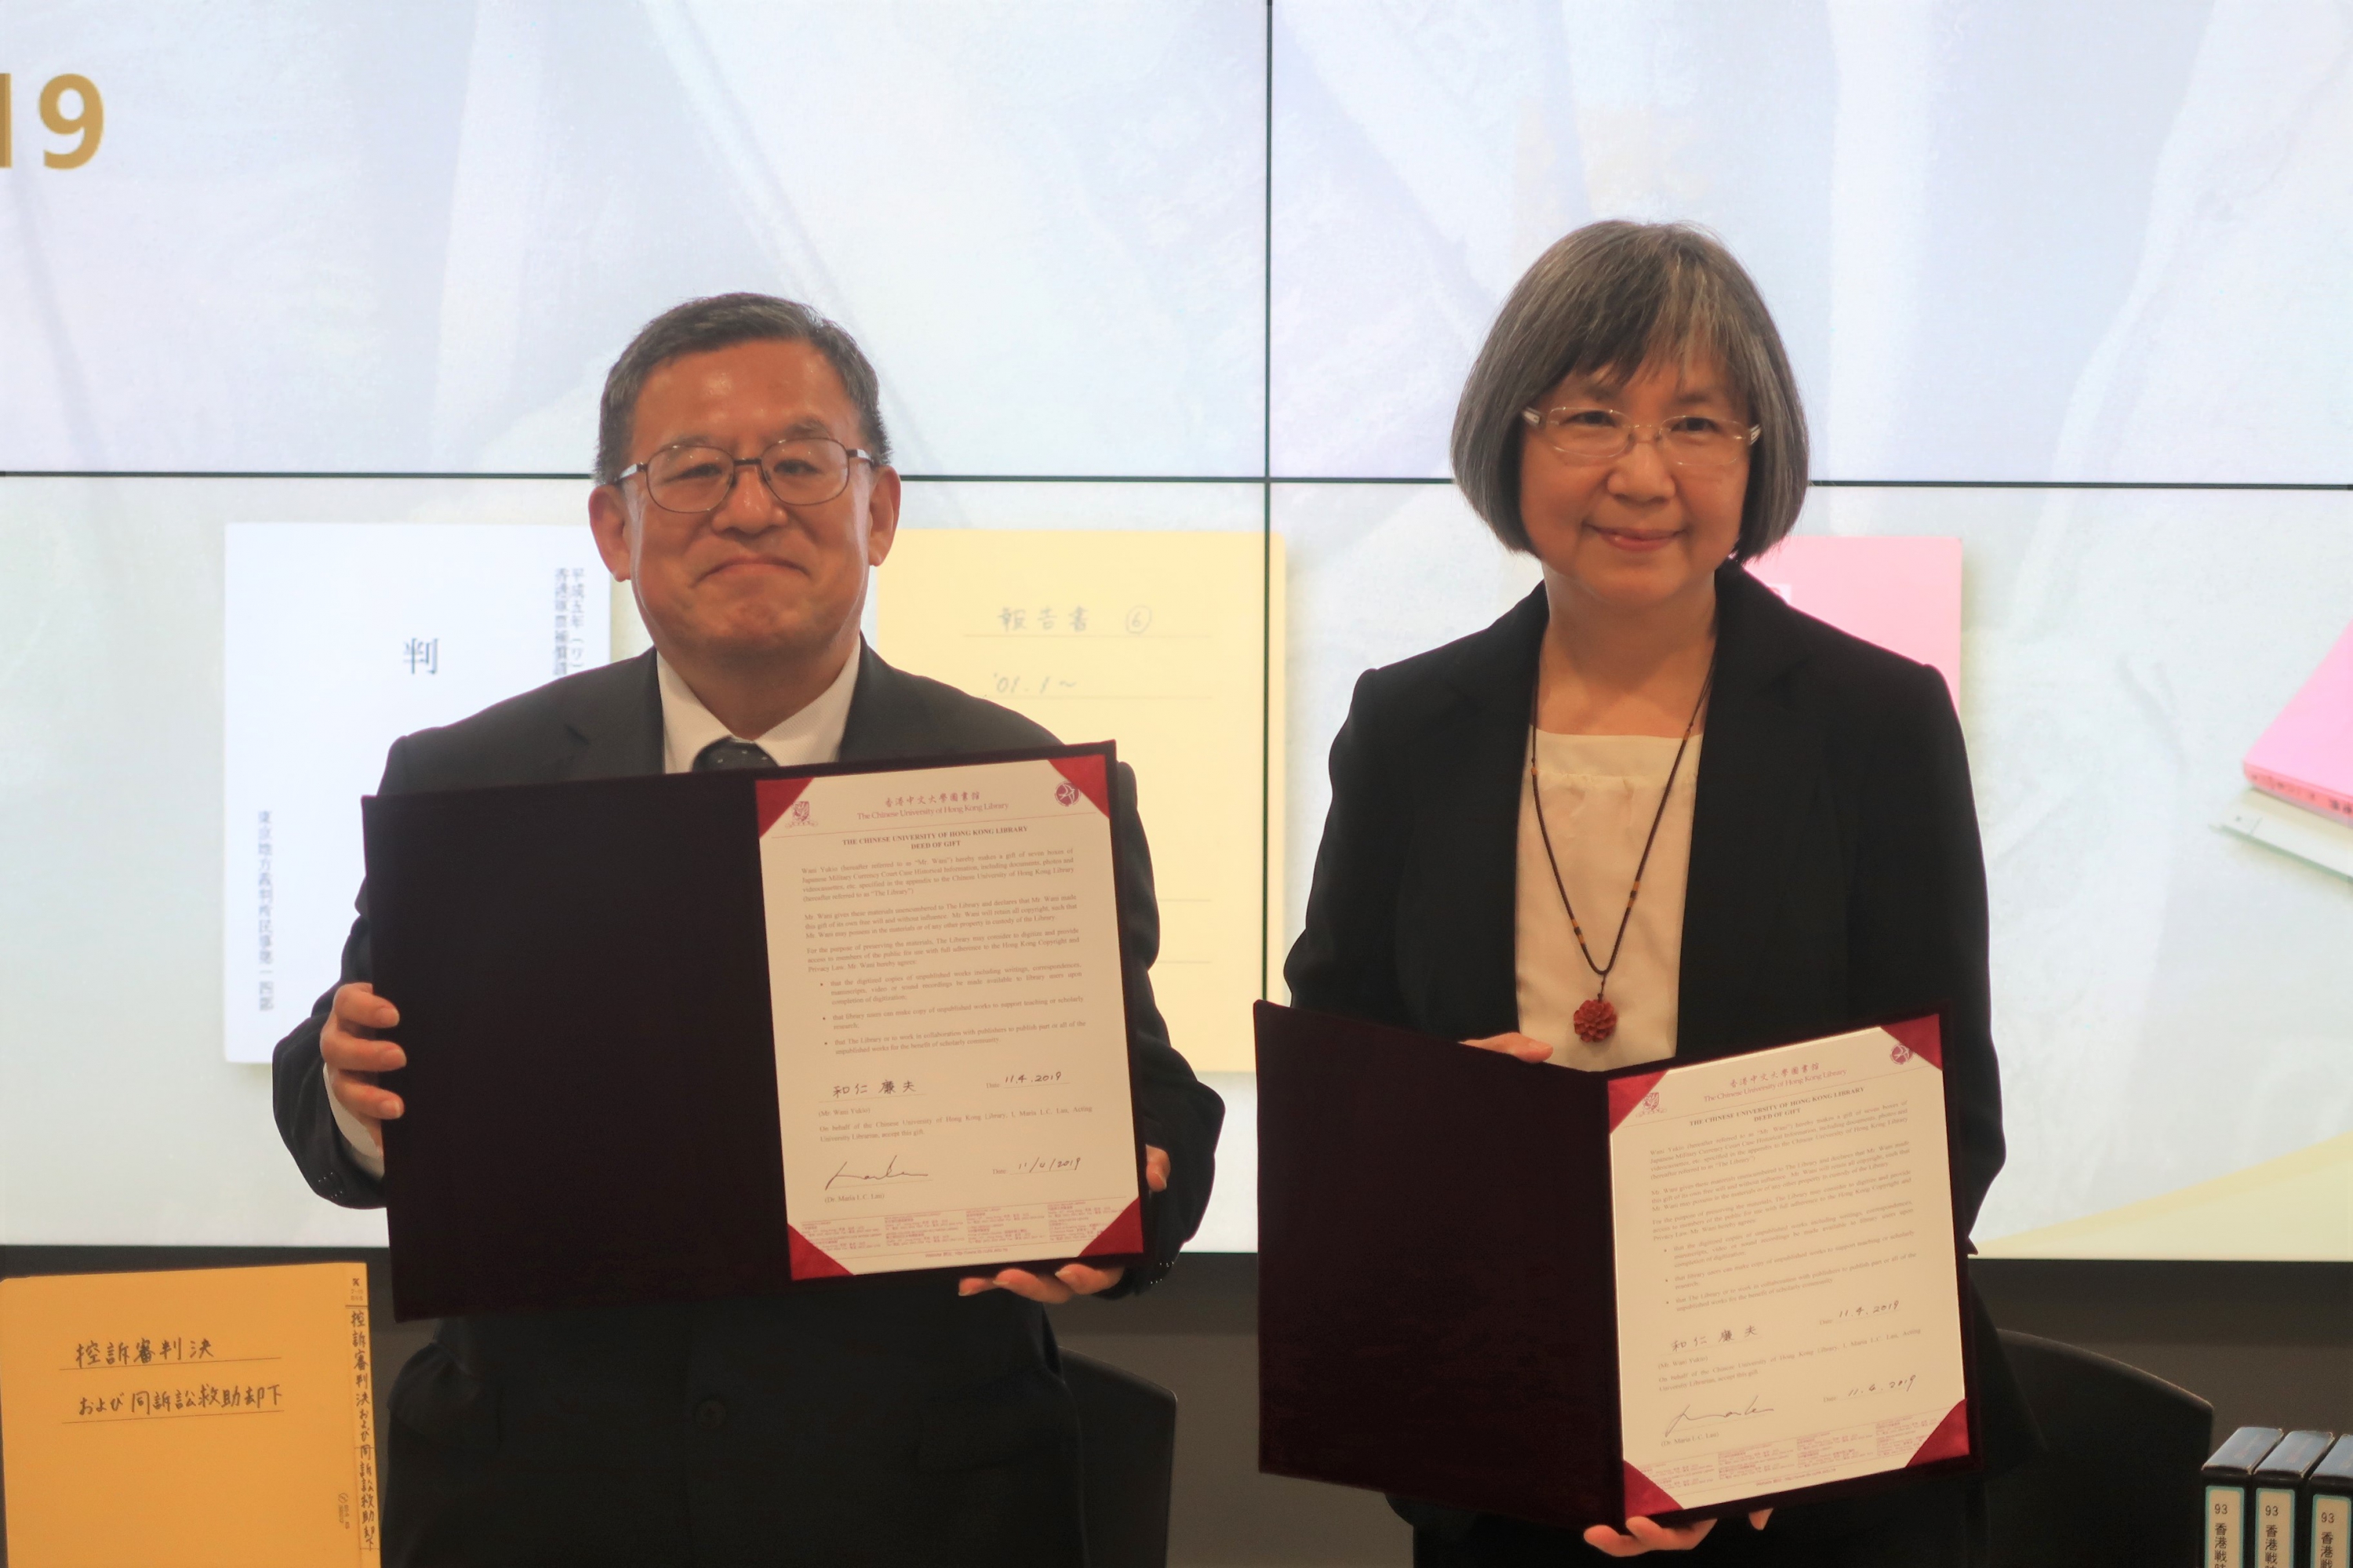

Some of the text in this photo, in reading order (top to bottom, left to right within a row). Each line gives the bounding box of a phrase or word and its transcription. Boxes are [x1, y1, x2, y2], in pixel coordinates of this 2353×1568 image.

[403, 638, 438, 675] 判
[900, 808, 934, 817] University
[892, 833, 936, 842] UNIVERSITY
[1717, 1090, 1742, 1100] Chinese
[1744, 1083, 1776, 1094] University
[1824, 1070, 1847, 1079] Library
[1705, 1112, 1735, 1123] CHINESE
[1736, 1104, 1777, 1117] UNIVERSITY
[1790, 1097, 1810, 1106] HONG
[1812, 1093, 1832, 1102] KONG
[1834, 1086, 1864, 1097] LIBRARY
[1754, 1113, 1773, 1122] DEED
[1784, 1108, 1801, 1116] GIFT
[76, 1337, 214, 1369] 控訴審判決
[2214, 1504, 2228, 1515] 93
[2265, 1505, 2278, 1516] 93
[2321, 1512, 2335, 1523] 93
[2264, 1525, 2278, 1568] 香港戦
